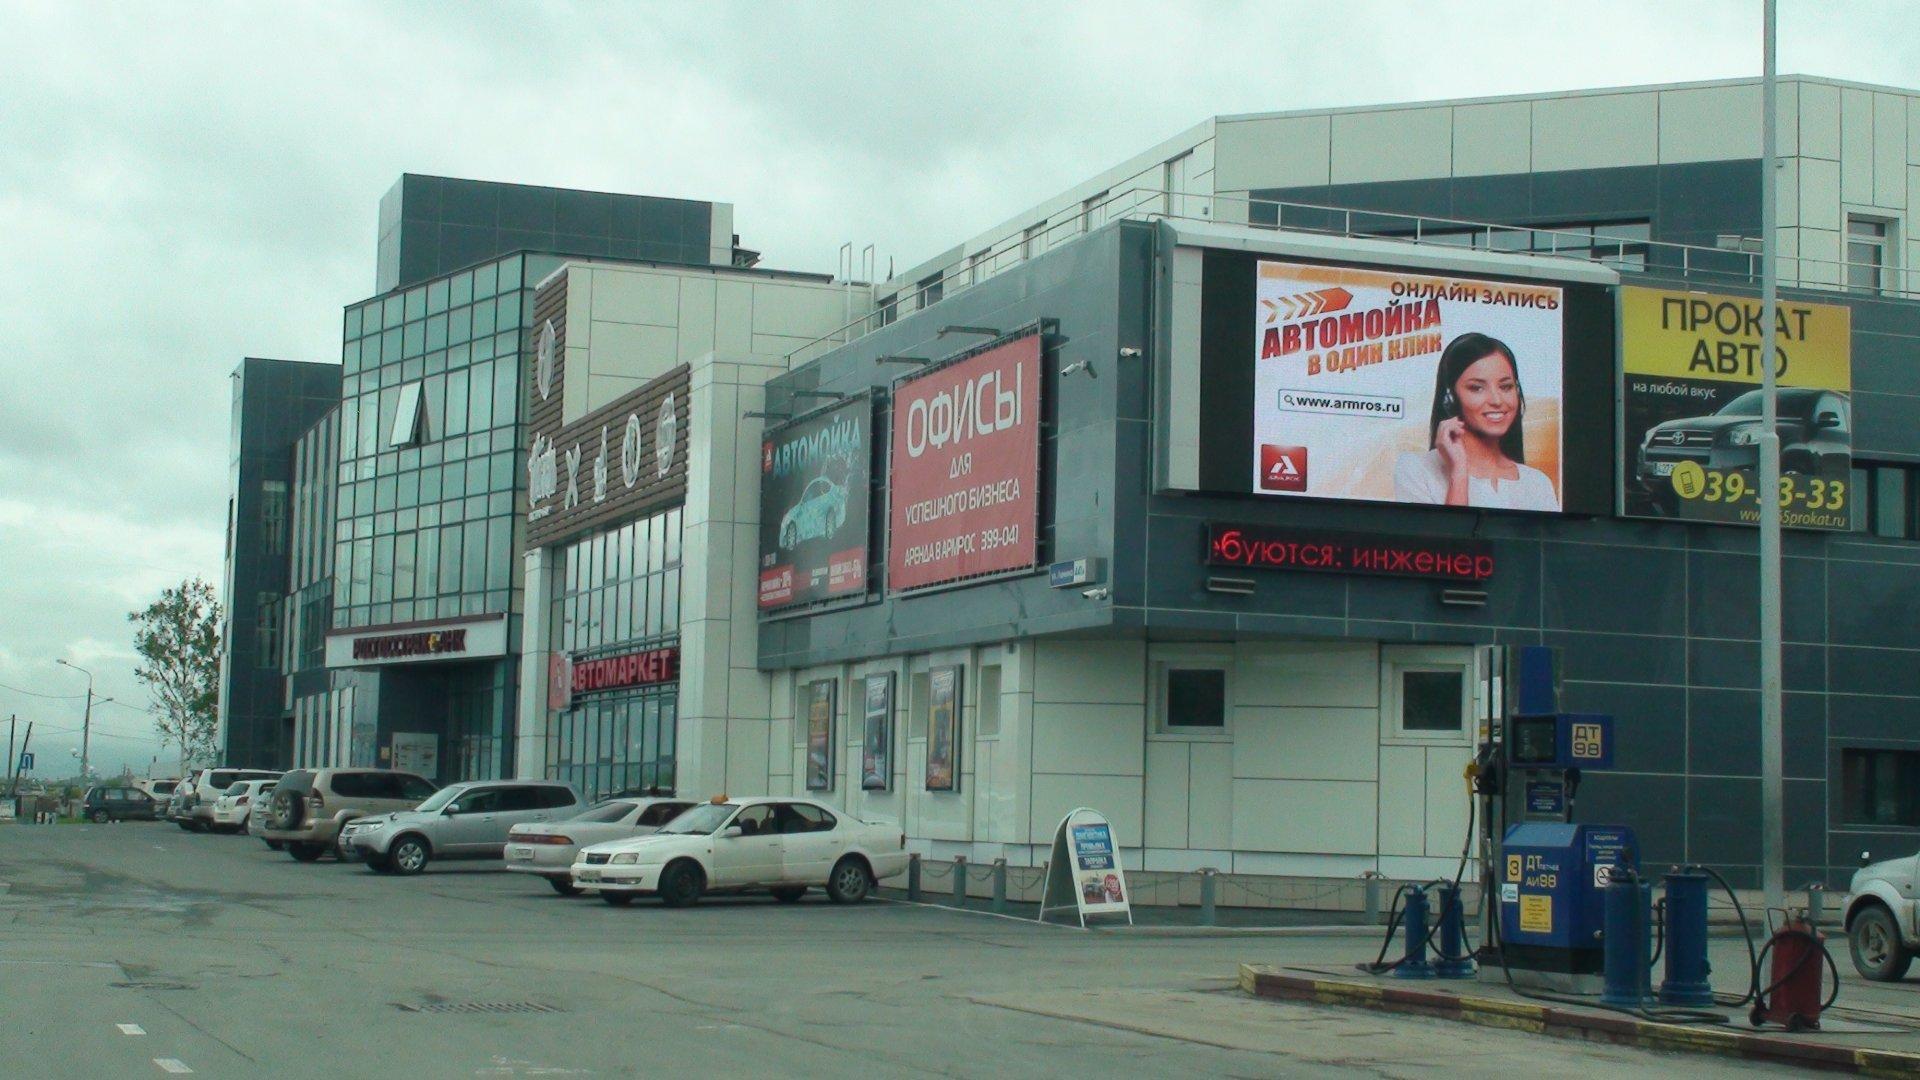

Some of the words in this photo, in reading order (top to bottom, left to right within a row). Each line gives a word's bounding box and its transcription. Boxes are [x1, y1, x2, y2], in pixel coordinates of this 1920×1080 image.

[1390, 280, 1477, 305] ОНЛАЙН
[1481, 287, 1560, 311] ЗАПИСЬ
[1261, 299, 1443, 361] АВТОМОЙКА
[1325, 342, 1384, 375] ОДИН
[1387, 331, 1443, 363] КЛИК
[1688, 339, 1789, 378] АВТО
[1296, 396, 1401, 414] www.armros.ru
[1632, 381, 1648, 393] на
[1649, 382, 1689, 396] любой
[1690, 387, 1717, 399] вкус
[906, 362, 1023, 459] ОФИСЫ
[773, 414, 862, 479] АВТОМОЙКА
[949, 452, 972, 479] ДЛЯ
[904, 490, 968, 526] УСПЕШНОГО
[968, 478, 1021, 509] БИЗНЕСА
[1704, 471, 1845, 510] 39-3-33
[904, 544, 935, 567] АРЕНДА
[980, 524, 1019, 551] 399-041
[1352, 546, 1495, 580] инженер
[572, 649, 671, 691] АВТОМАРКЕТ
[1574, 726, 1600, 741] ДТ
[1574, 743, 1600, 756] 98
[1509, 860, 1520, 876] 3
[1526, 855, 1543, 872] ДТ
